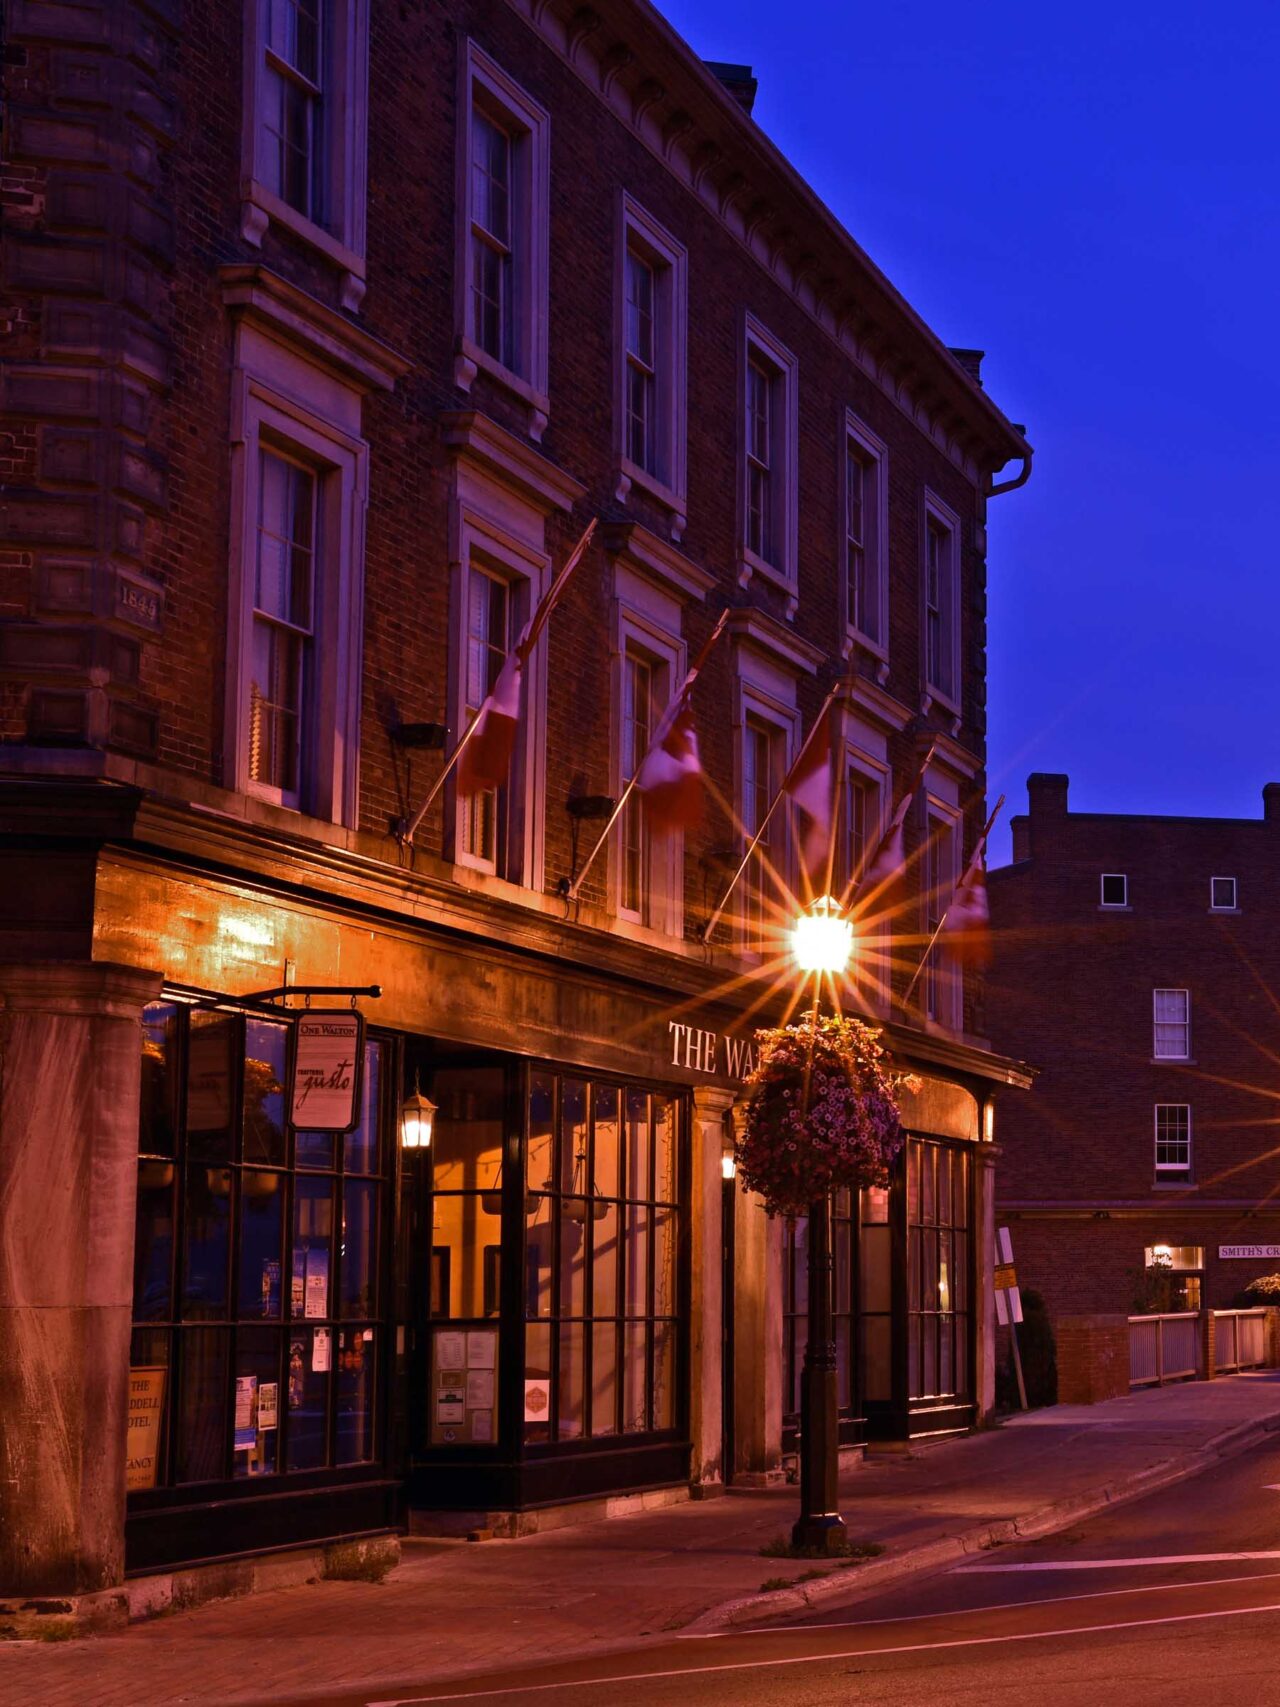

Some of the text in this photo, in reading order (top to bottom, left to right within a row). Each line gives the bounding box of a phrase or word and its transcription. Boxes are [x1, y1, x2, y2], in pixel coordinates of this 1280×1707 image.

[321, 1025, 355, 1035] WALTON
[668, 1021, 716, 1074] THE
[296, 1060, 353, 1110] gusto
[1221, 1246, 1263, 1257] SMITH'S
[131, 1381, 150, 1392] THE
[128, 1397, 160, 1410] DDELL
[127, 1457, 152, 1469] ANCY
